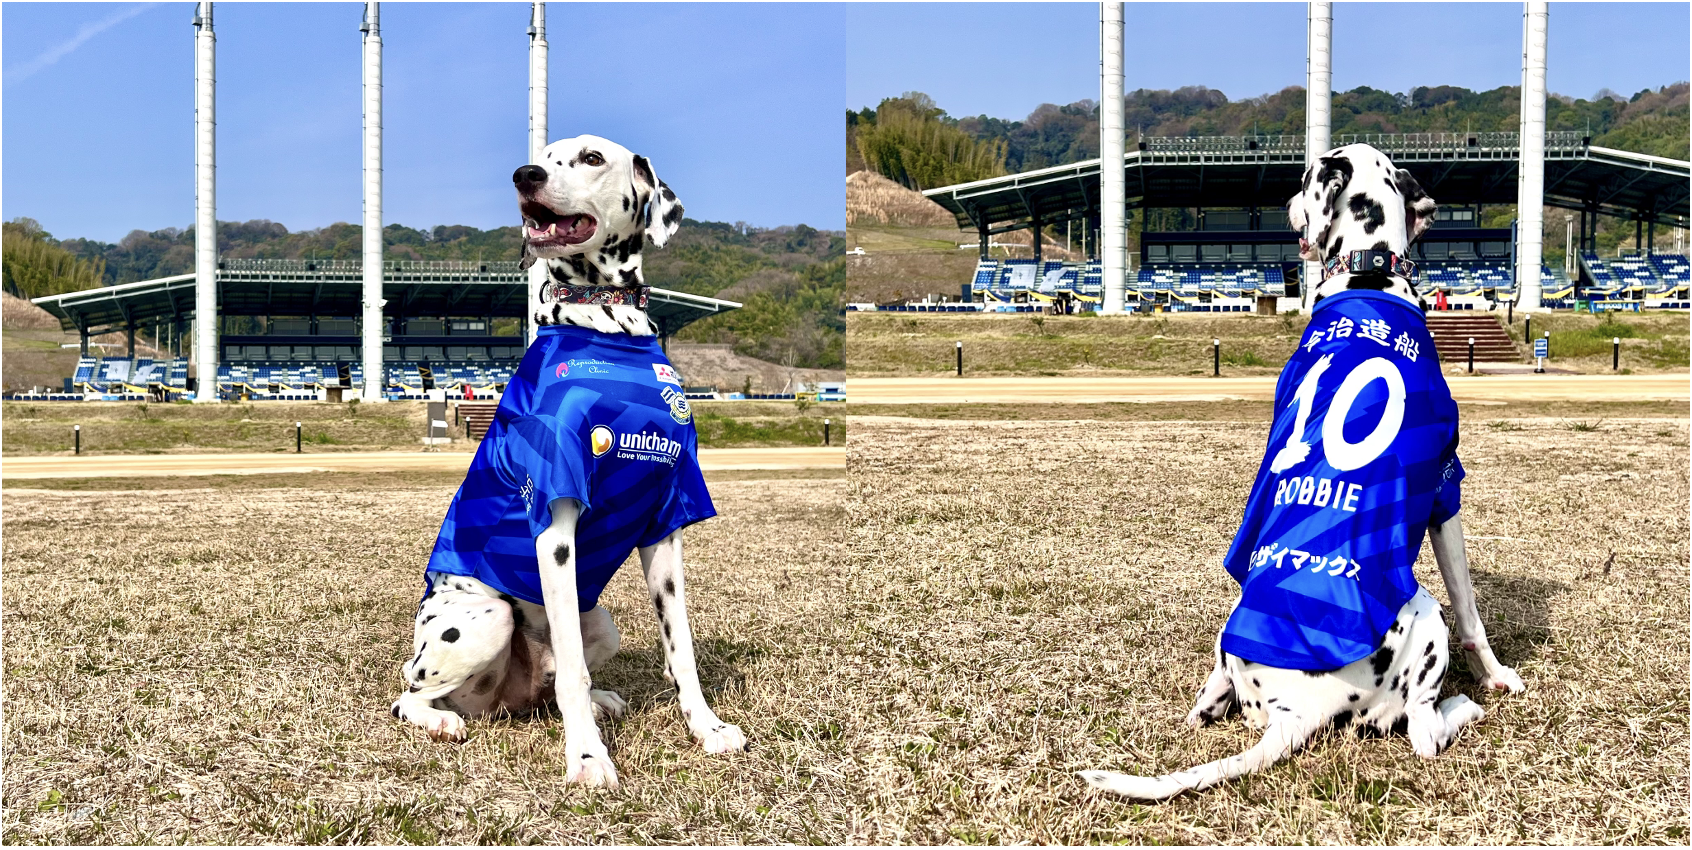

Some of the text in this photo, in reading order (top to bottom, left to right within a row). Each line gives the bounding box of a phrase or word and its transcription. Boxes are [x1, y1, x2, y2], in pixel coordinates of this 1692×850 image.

[1301, 316, 1420, 362] 今治造船
[1269, 352, 1406, 474] 10
[616, 450, 635, 460] Love
[636, 452, 651, 461] Your
[619, 430, 682, 458] unicham
[1273, 475, 1363, 512] ROBBIE
[1255, 542, 1361, 581] ザイマックス
